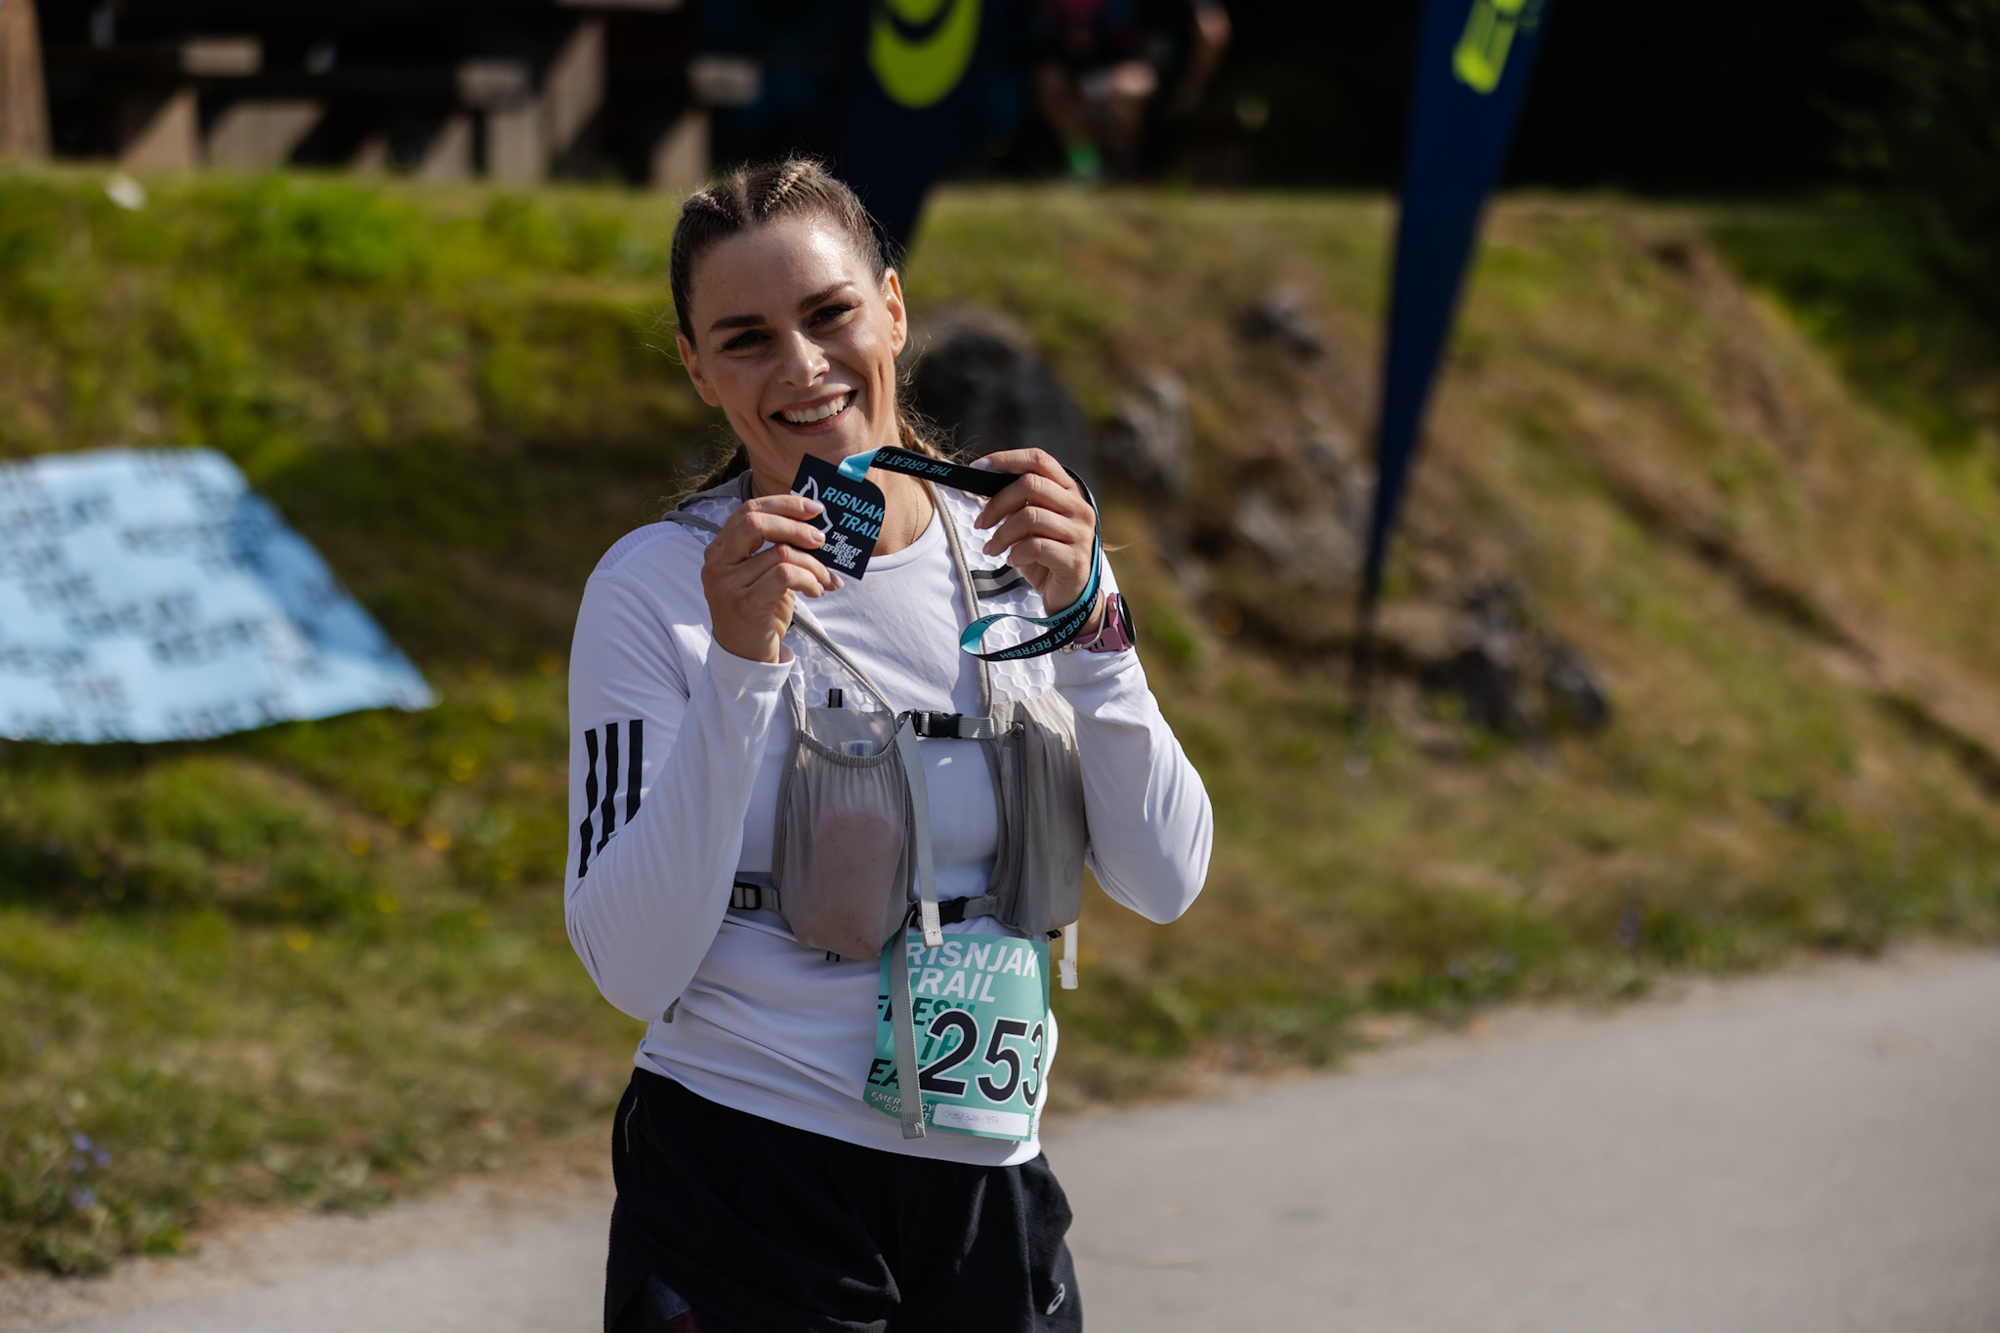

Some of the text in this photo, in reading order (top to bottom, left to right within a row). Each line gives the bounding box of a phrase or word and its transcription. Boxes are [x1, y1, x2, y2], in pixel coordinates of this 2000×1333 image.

[886, 454, 928, 471] GREAT
[926, 464, 952, 477] THE
[821, 486, 885, 522] RISNJAK
[839, 512, 881, 540] TRAIL
[831, 531, 848, 543] THE
[836, 542, 862, 557] GREAT
[1054, 611, 1087, 645] GREAT
[1000, 638, 1053, 659] REFRESH
[907, 941, 1040, 978] RISNJAK
[919, 1008, 1044, 1109] 253
[871, 1091, 934, 1112] EMERCY
